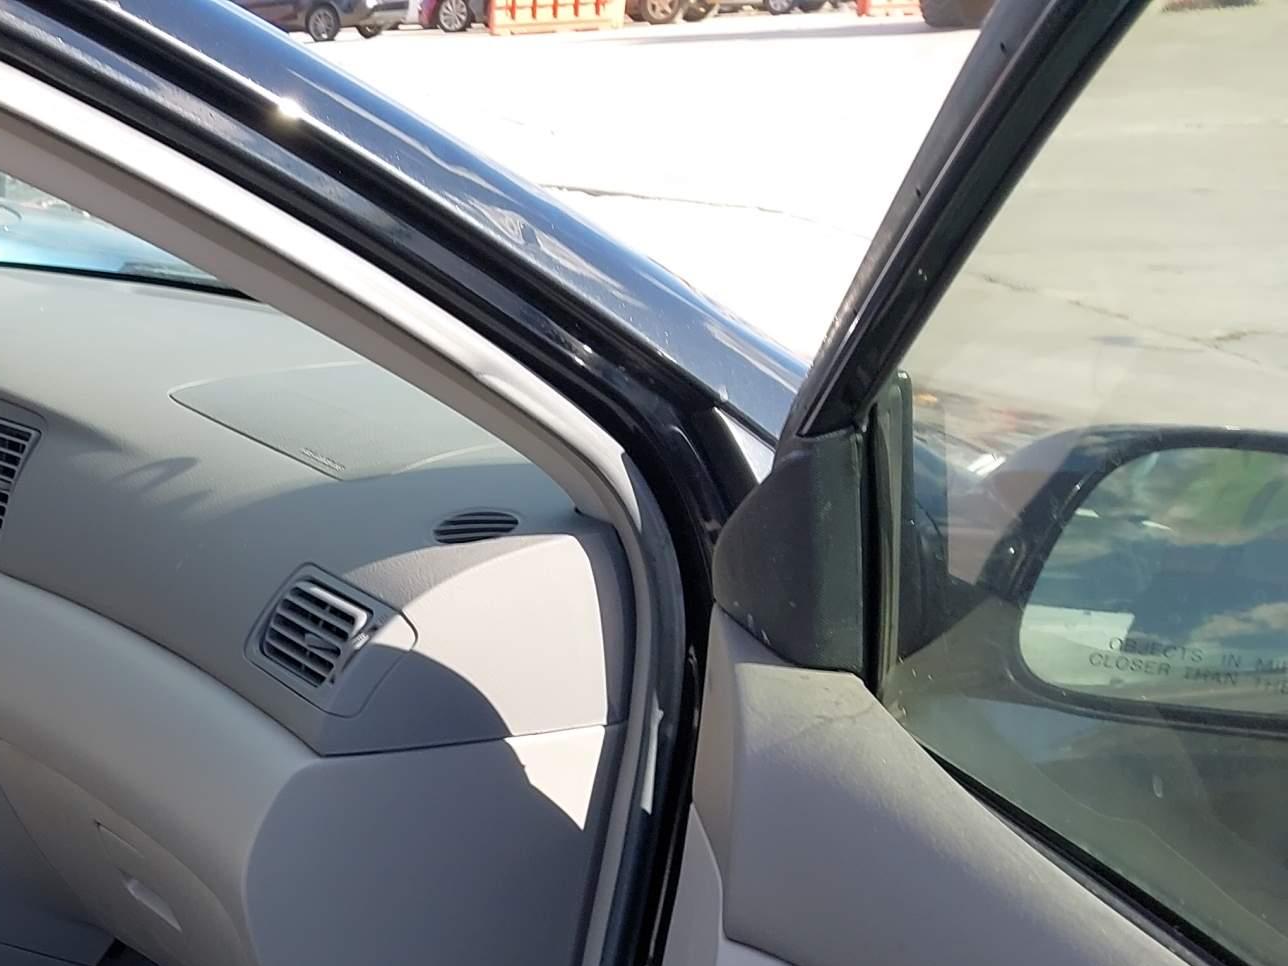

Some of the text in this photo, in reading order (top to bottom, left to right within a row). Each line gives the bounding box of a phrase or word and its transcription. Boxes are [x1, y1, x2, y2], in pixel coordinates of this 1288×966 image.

[1089, 651, 1170, 676] CLOSER
[1109, 636, 1203, 663] OBJECTS
[1223, 653, 1241, 669] IN
